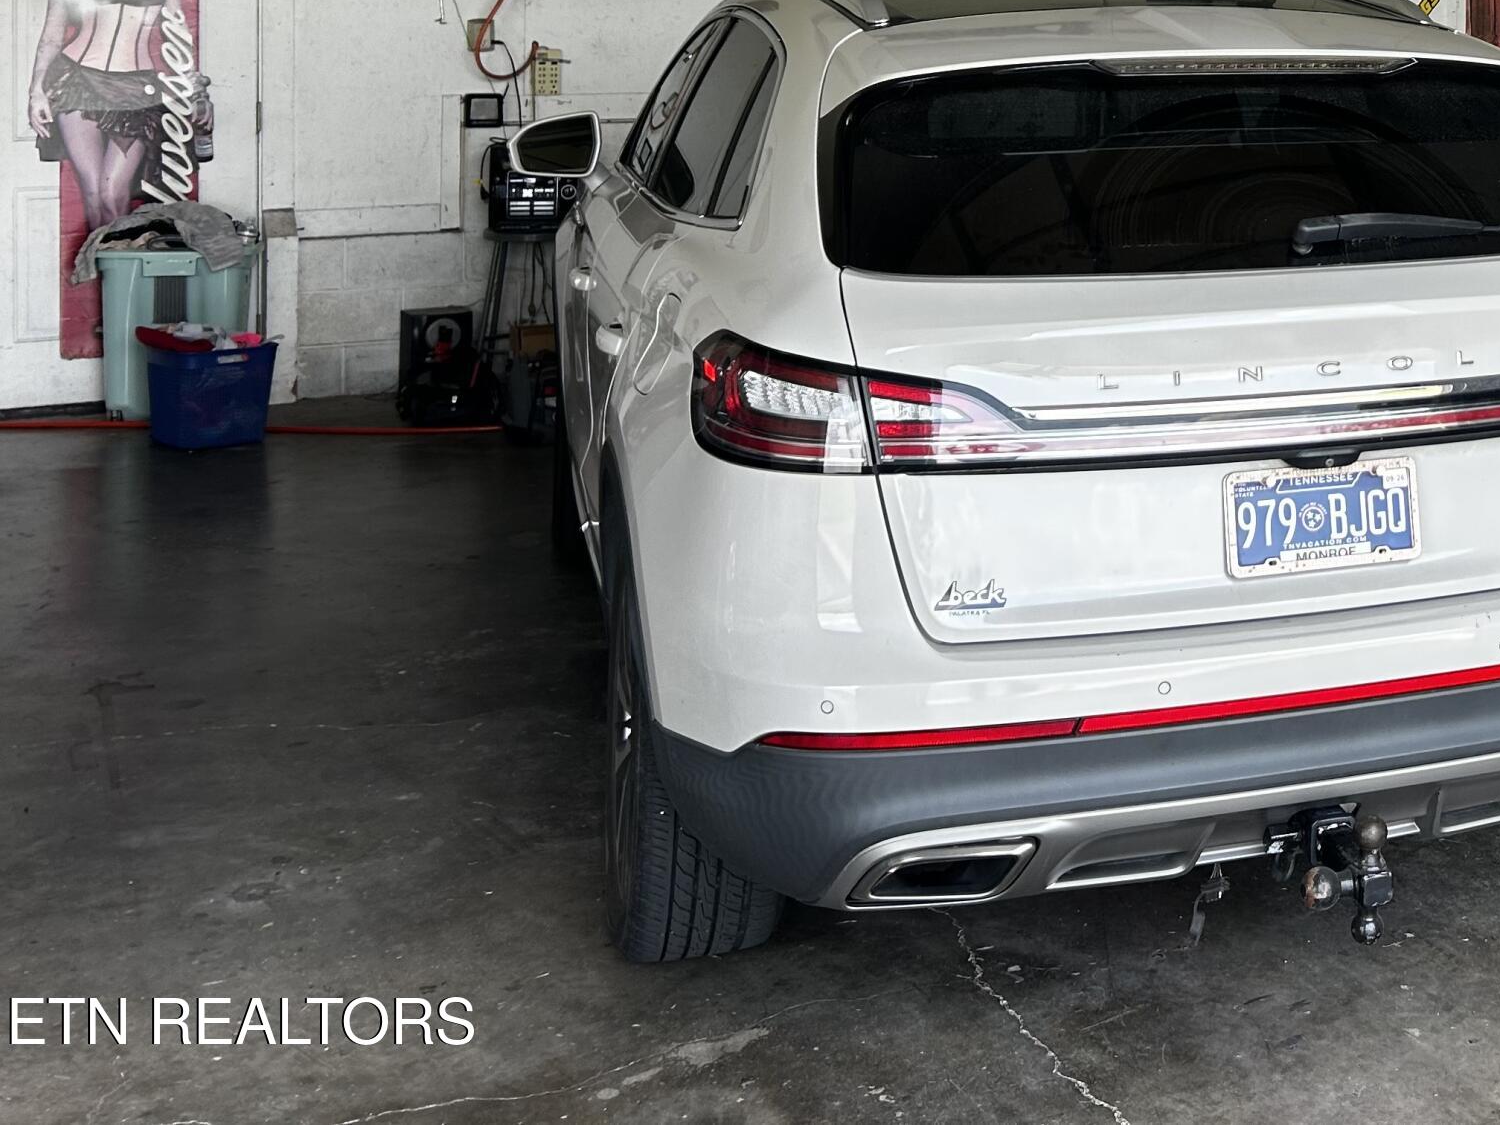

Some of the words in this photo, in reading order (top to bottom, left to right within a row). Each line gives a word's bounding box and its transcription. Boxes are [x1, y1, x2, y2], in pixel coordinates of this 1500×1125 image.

[141, 6, 195, 205] weiser
[1288, 474, 1354, 486] TENNESSEE
[1238, 497, 1297, 549] 979
[1328, 488, 1407, 540] BJGQ
[1283, 536, 1367, 550] TNVACATION.COM
[1296, 546, 1357, 561] MONROE
